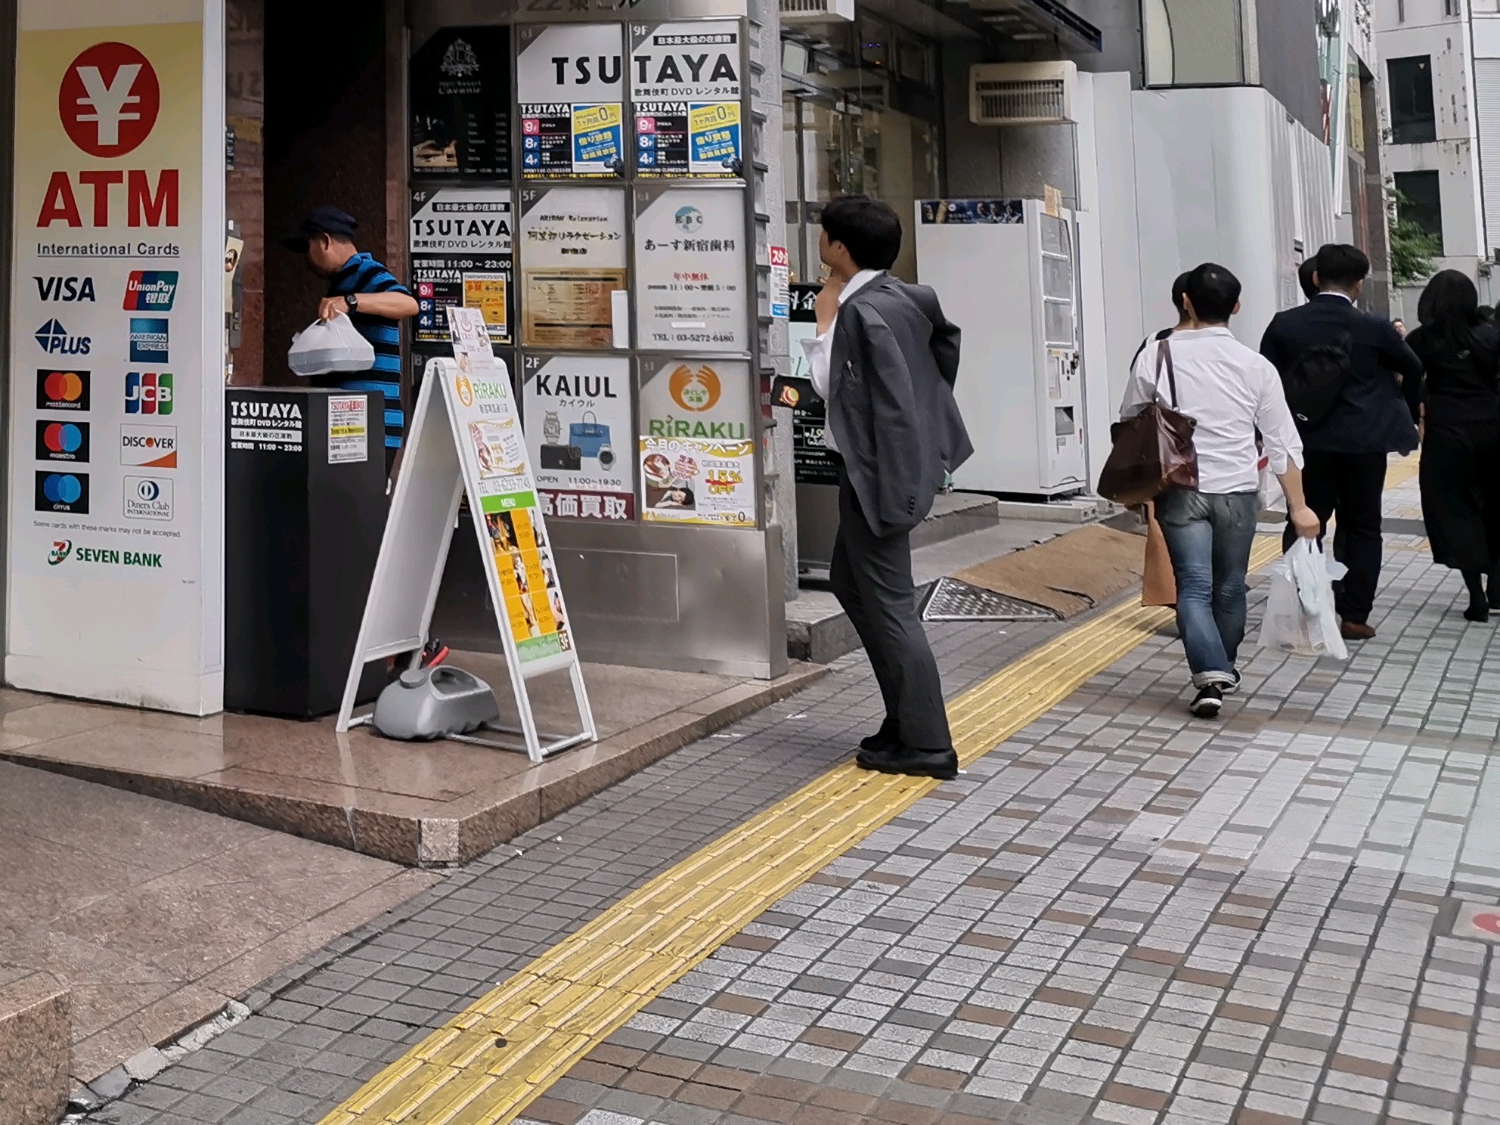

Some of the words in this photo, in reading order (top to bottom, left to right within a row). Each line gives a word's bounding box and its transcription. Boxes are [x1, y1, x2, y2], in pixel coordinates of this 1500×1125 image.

[633, 26, 648, 36] 9F
[671, 88, 693, 96] DVD
[521, 104, 570, 114] TSUTAYA
[636, 102, 687, 112] TSUTAYA
[37, 169, 179, 227] ATM
[413, 191, 426, 202] 4F
[522, 190, 536, 202] 5F
[413, 219, 510, 236] TSUTAYA
[37, 242, 131, 255] International
[137, 242, 180, 255] Cards
[448, 240, 468, 248] DVD
[644, 238, 735, 252] あーす新宿歯科
[447, 260, 473, 269] 11:00
[485, 260, 512, 268] 23:00
[417, 269, 461, 279] TSUTAYA
[32, 276, 96, 302] VISA
[128, 279, 175, 299] UnionPay
[49, 336, 91, 355] PLUS
[525, 358, 540, 369] 2F
[536, 375, 617, 398] KAIUL
[125, 385, 172, 402] JCB
[231, 401, 302, 418] TSUTAYA
[559, 399, 595, 408] カイウル
[257, 419, 271, 427] DVD
[122, 436, 174, 448] DISCOVER
[259, 443, 277, 452] 11:00
[284, 444, 302, 453] 23:00
[645, 438, 750, 456] 今月のキャンペーン
[536, 475, 559, 483] OPEN
[127, 499, 150, 510] Diners
[152, 502, 170, 511] Club
[76, 547, 120, 564] SEVEN
[123, 551, 162, 567] BANK
